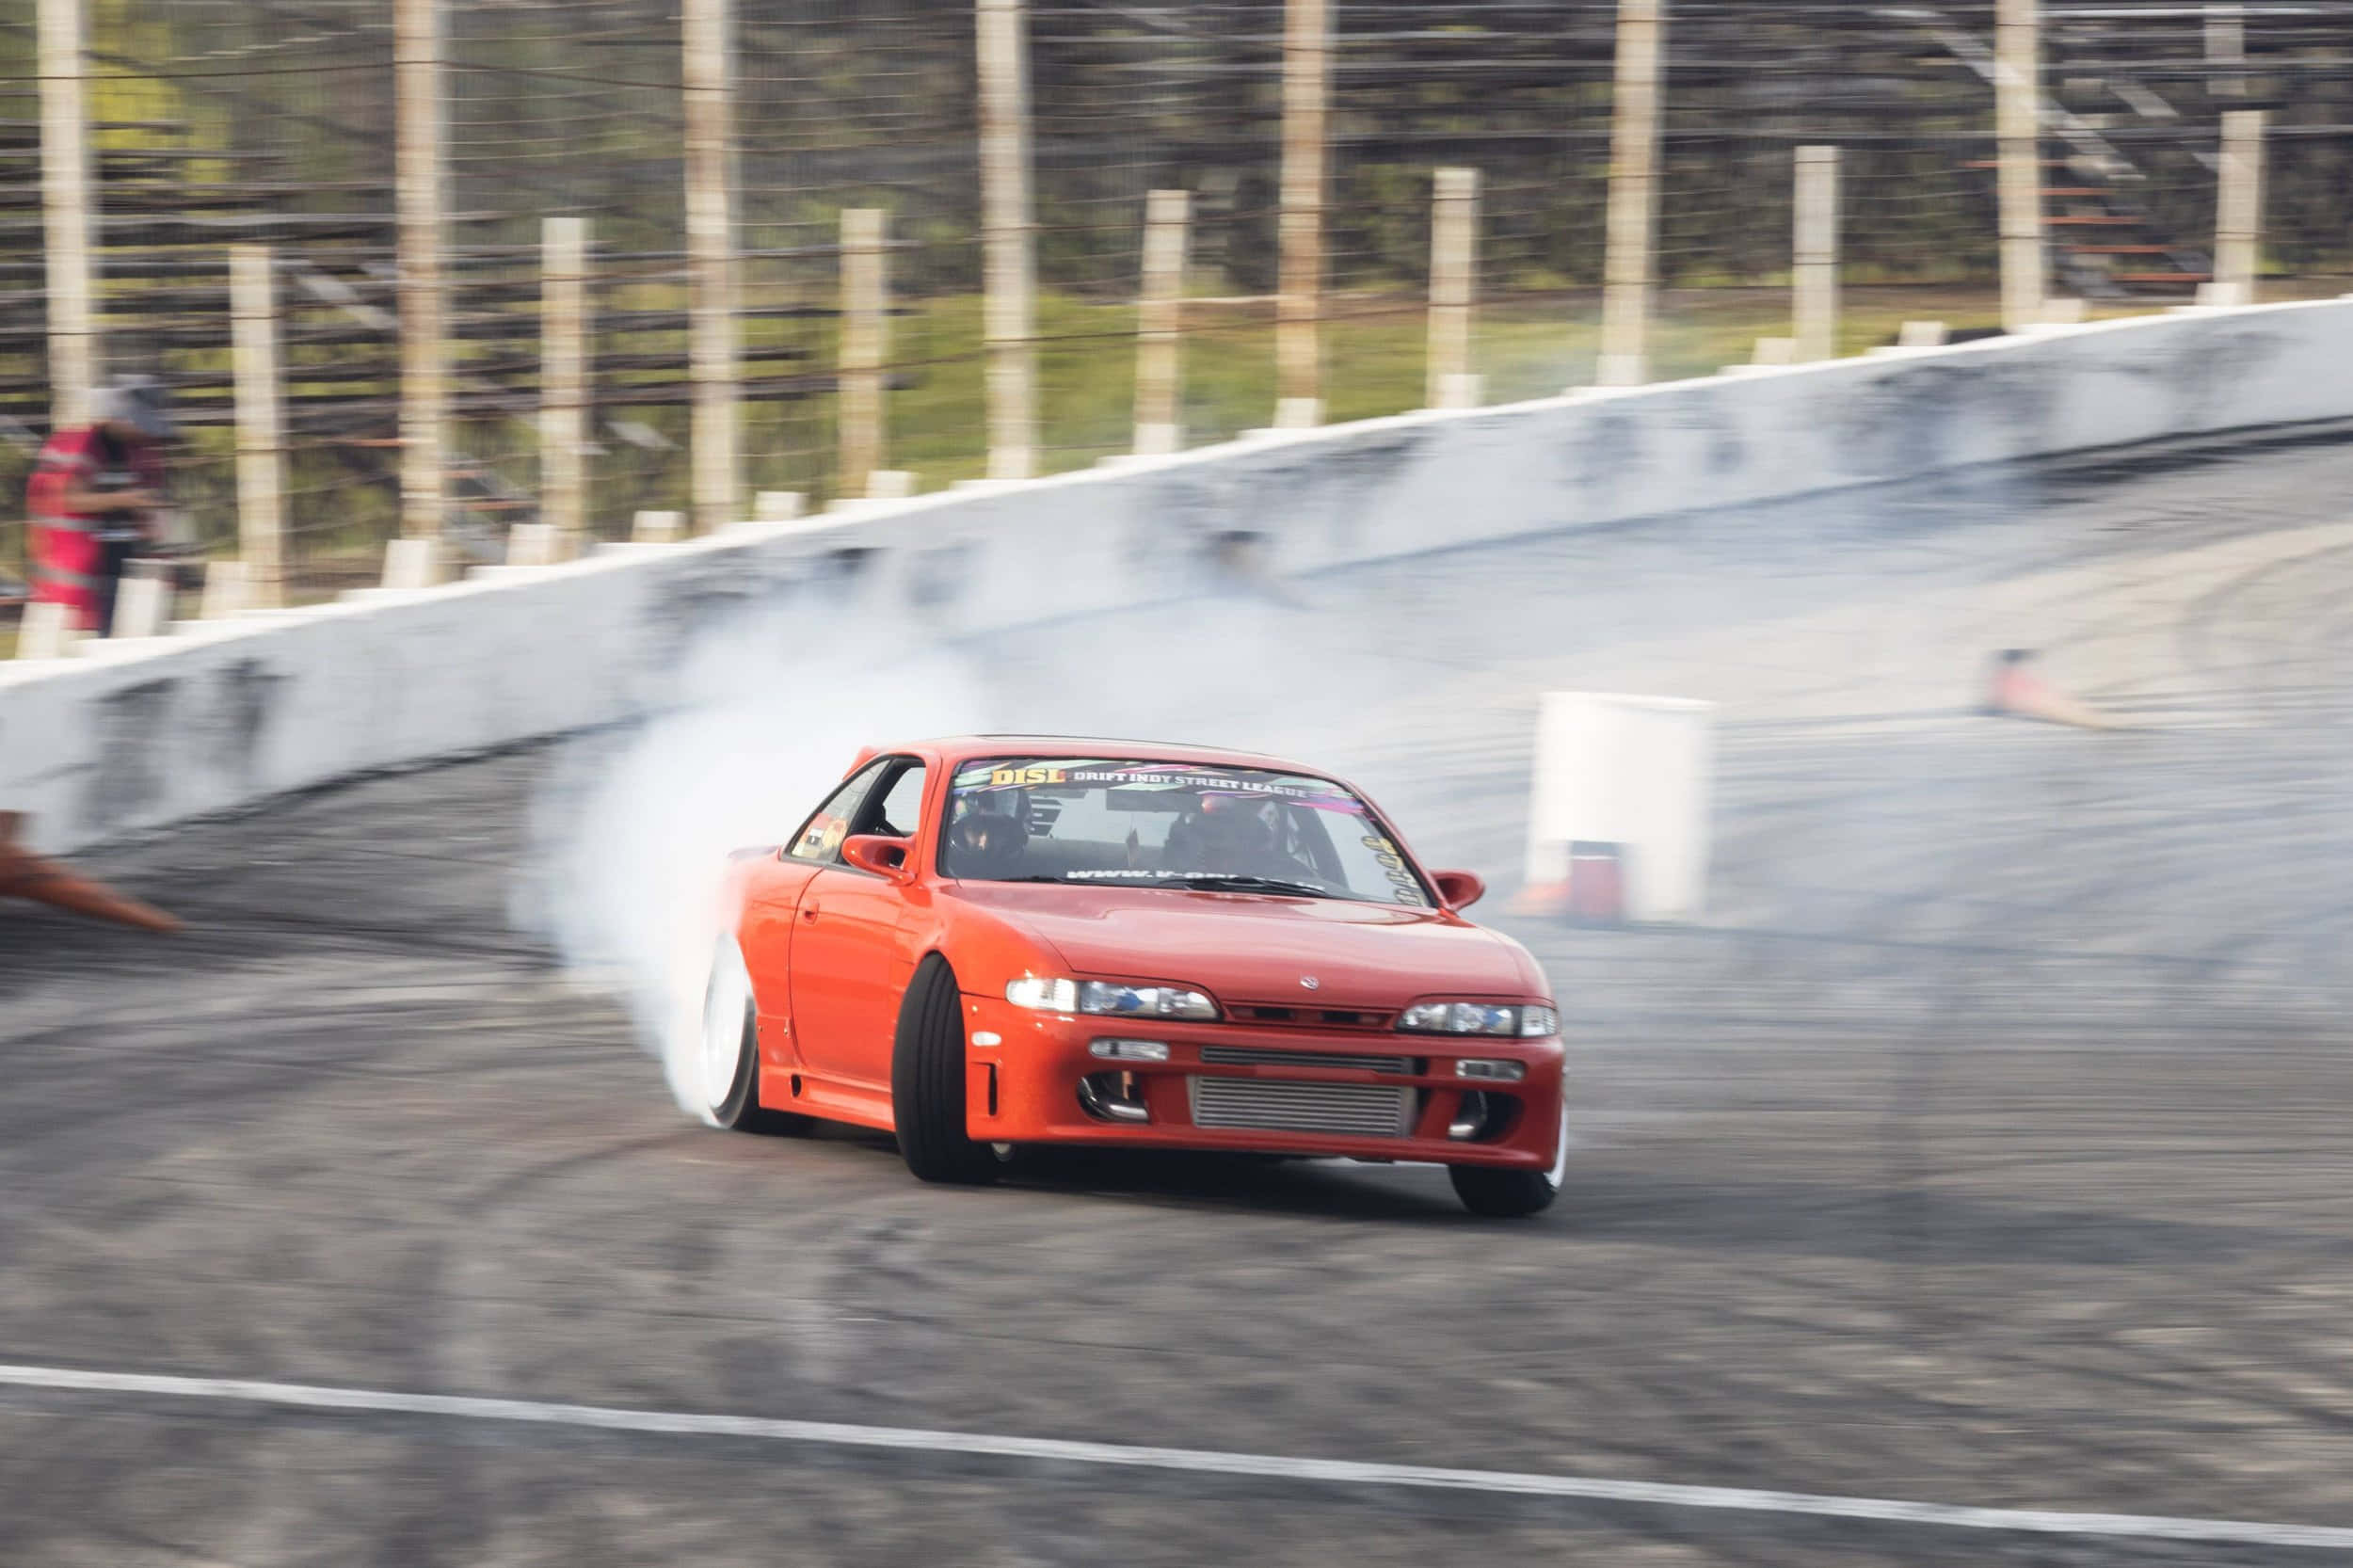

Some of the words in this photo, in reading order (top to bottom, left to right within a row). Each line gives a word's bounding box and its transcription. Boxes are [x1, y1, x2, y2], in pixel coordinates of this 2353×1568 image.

[991, 768, 1066, 786] DISL
[1074, 772, 1128, 782] DRIFT
[1129, 774, 1174, 784] INDY
[1175, 776, 1240, 790] STREET
[1241, 781, 1309, 798] LEAGUE
